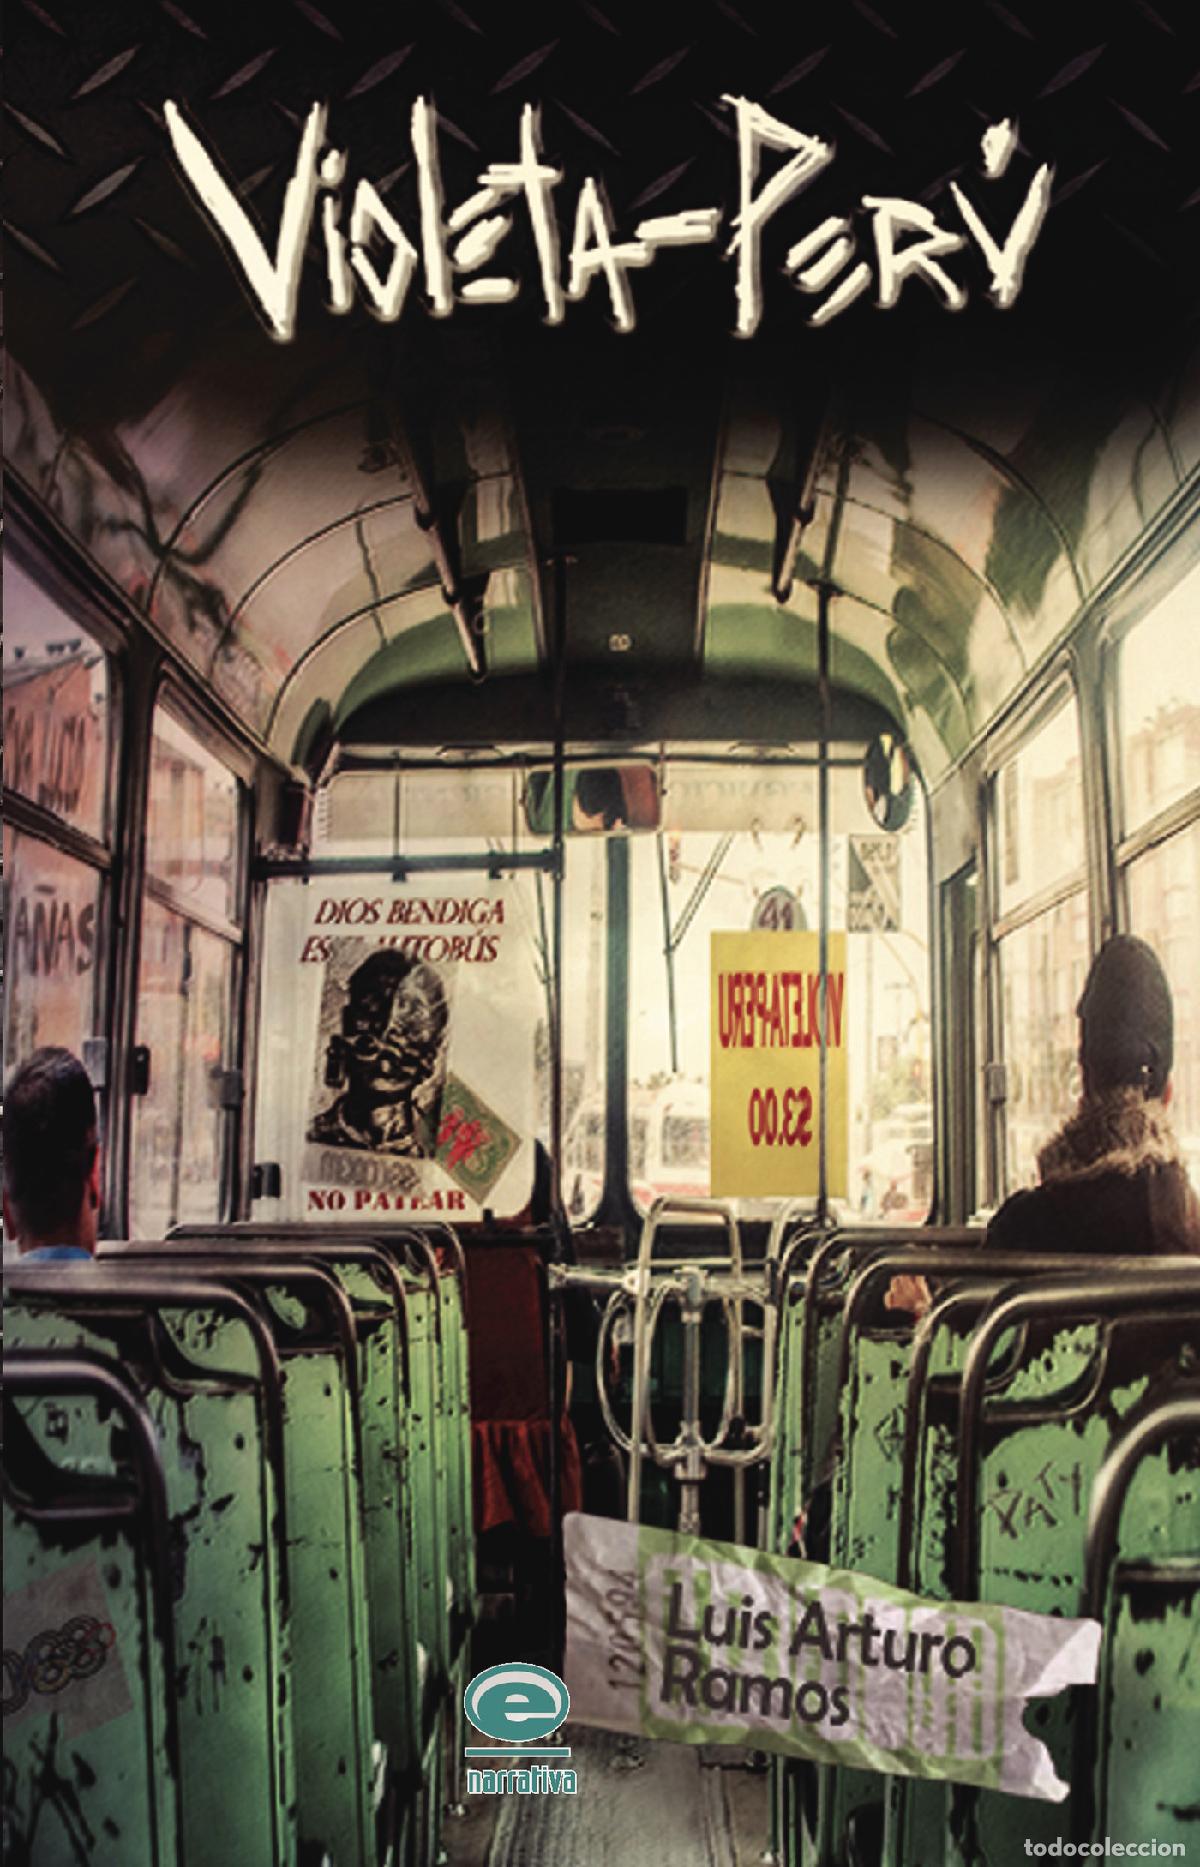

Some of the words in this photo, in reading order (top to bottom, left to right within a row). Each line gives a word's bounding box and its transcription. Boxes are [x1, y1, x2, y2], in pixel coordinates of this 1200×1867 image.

[314, 897, 382, 925] DIOS
[387, 897, 505, 925] BENDIGA
[379, 929, 500, 963] TOBÚS
[307, 1190, 346, 1211] NO
[664, 1583, 773, 1650] Luis
[788, 1600, 977, 1678] Arturo
[660, 1645, 851, 1726] Ramos
[467, 1765, 577, 1794] narrativa
